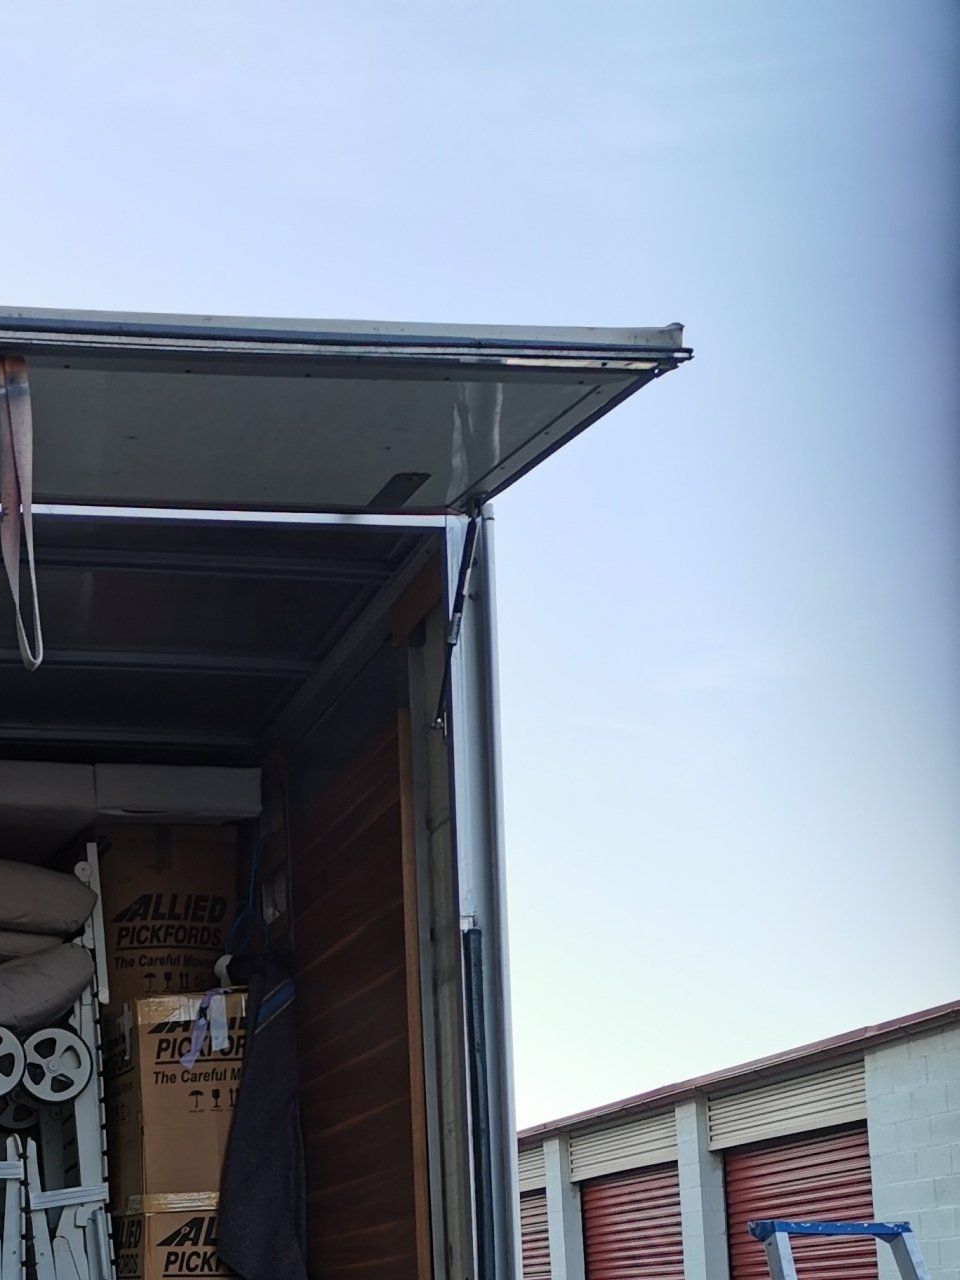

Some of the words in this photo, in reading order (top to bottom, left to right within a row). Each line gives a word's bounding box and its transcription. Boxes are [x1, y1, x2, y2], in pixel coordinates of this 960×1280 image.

[110, 893, 227, 923] ALLIED
[116, 926, 222, 946] PICKFORDS
[114, 956, 135, 969] The
[139, 953, 181, 967] Careful
[153, 1070, 177, 1084] The
[181, 1067, 227, 1083] Careful
